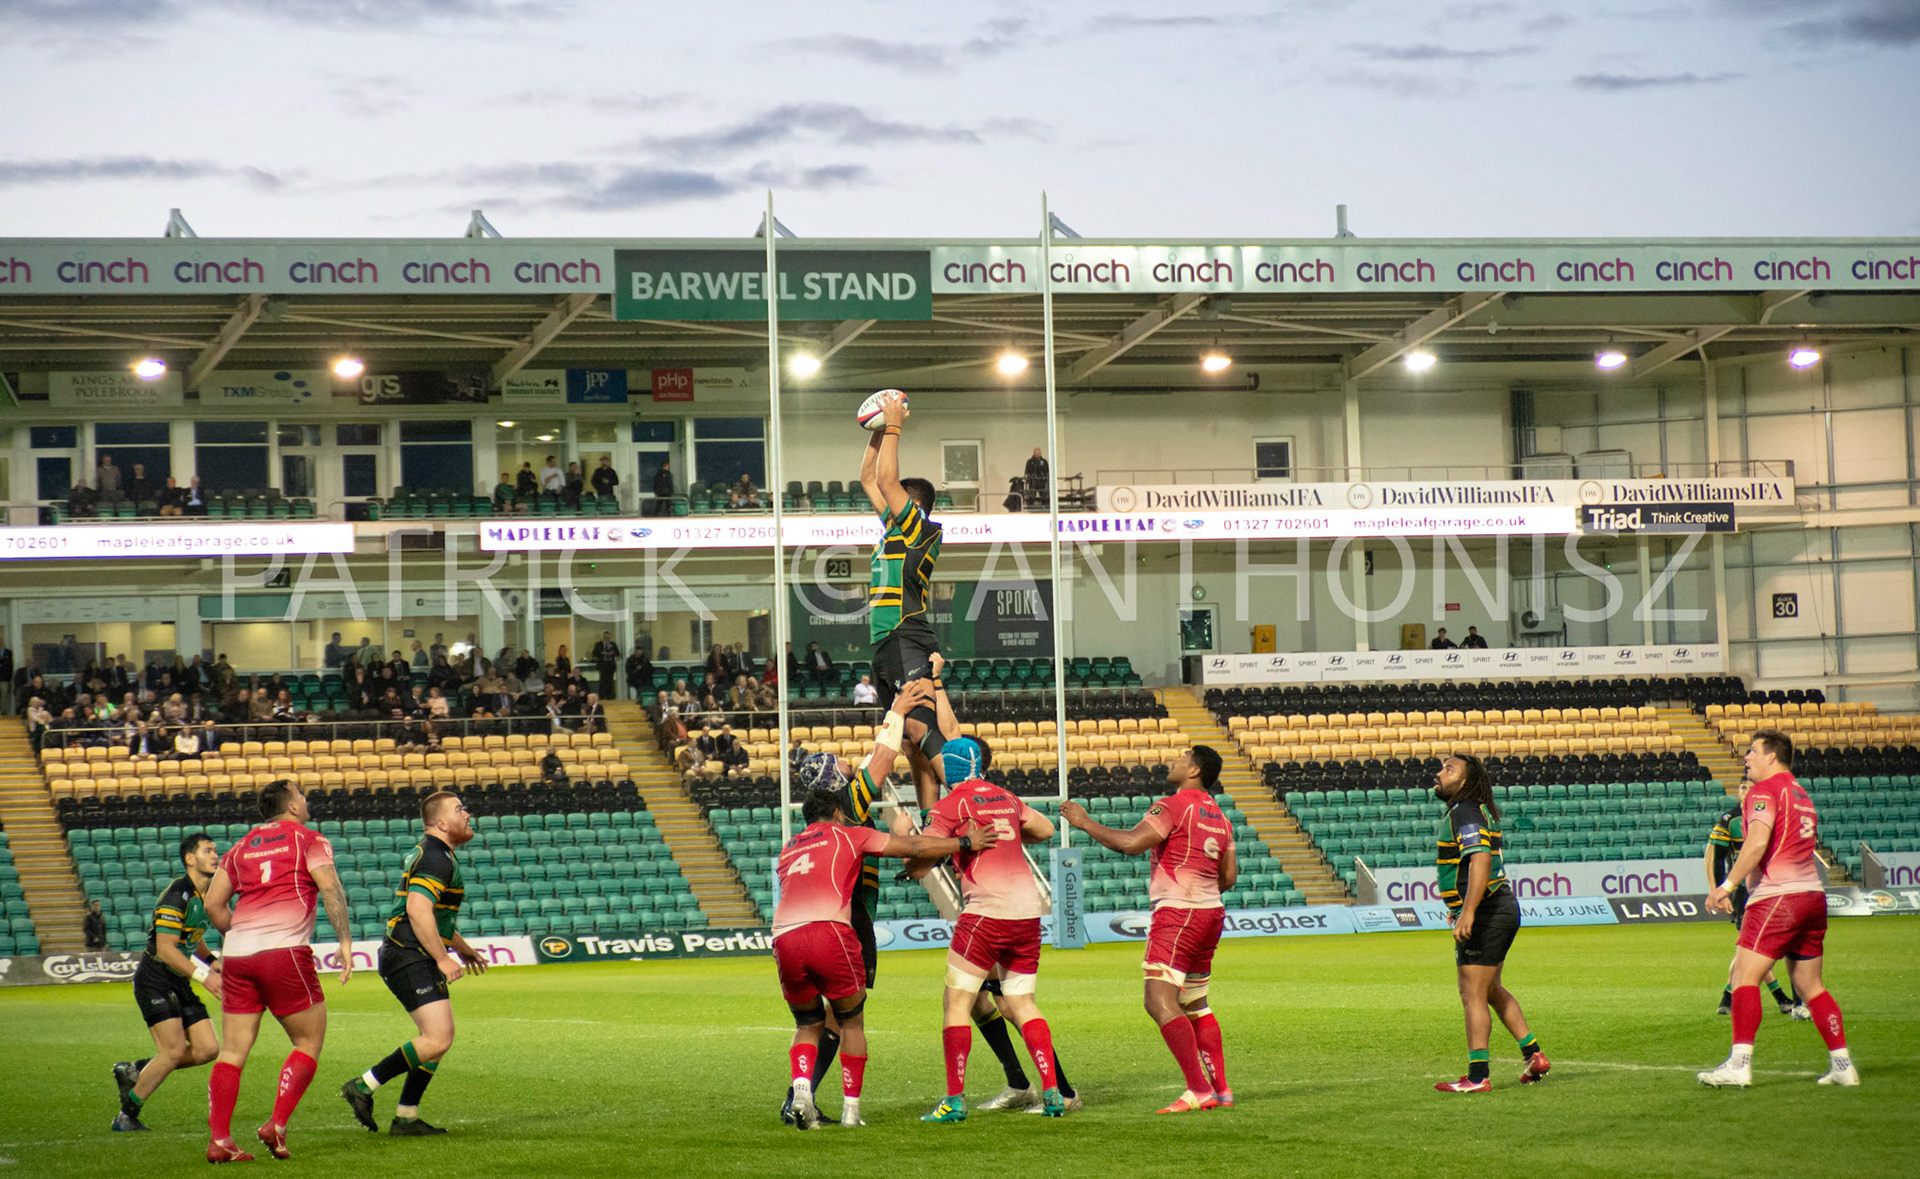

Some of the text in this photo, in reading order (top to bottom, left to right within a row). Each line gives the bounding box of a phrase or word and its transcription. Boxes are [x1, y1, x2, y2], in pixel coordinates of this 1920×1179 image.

[57, 257, 149, 284] cinch
[173, 257, 265, 284] cinch
[288, 257, 379, 284] cinch
[402, 257, 491, 284] cinch
[513, 257, 601, 284] cinch
[943, 258, 1026, 284] cinch
[1050, 258, 1130, 283] cinch
[1152, 258, 1233, 283] cinch
[1254, 258, 1335, 283] cinch
[1356, 258, 1436, 283] cinch
[1456, 257, 1535, 282] cinch
[1556, 257, 1635, 282] cinch
[1655, 257, 1733, 281] cinch
[1753, 256, 1831, 281] cinch
[631, 271, 917, 301] BARWELL STAND
[1145, 487, 1324, 509] DavidWilliamsIFA
[1381, 484, 1556, 506] DavidWilliamsIFA
[1612, 481, 1784, 502] DavidWilliamsIFA
[1115, 518, 1156, 531] LEAF
[1223, 518, 1269, 531] 01327
[1276, 518, 1330, 530] 702601
[1353, 515, 1527, 530] mapleleafgarage.co.uk
[1588, 507, 1646, 530] Triad.
[1651, 511, 1730, 524] Think Creative
[6, 535, 296, 550] 702601 mapleleafgarage.co.uk
[488, 526, 552, 541] MAPLE
[557, 526, 601, 540] LEAF
[673, 527, 721, 540] 01327
[828, 562, 849, 576] 28
[997, 589, 1038, 616] SPOKE
[1775, 601, 1796, 616] 30
[1298, 660, 1317, 668] SPIRIT
[1472, 656, 1491, 664] SPIRIT
[1530, 655, 1549, 663] SPIRIT
[1644, 652, 1663, 660] SPIRIT
[992, 818, 1016, 841] 5
[1204, 837, 1221, 860] 6
[260, 860, 271, 884] 1
[787, 853, 815, 876] 4
[1387, 879, 1442, 902] cinc
[1512, 872, 1572, 897] inch
[1601, 868, 1679, 894] cinch
[1064, 872, 1078, 940] Gallagher
[1546, 906, 1564, 918] 18
[1565, 904, 1608, 917] JUNE
[1620, 900, 1699, 919] LAND
[577, 935, 675, 955] Travis
[42, 953, 141, 980] Carlsber
[957, 1053, 965, 1084] ARMY
[1036, 1050, 1049, 1076] ARMY
[279, 1066, 294, 1097] ARMY
